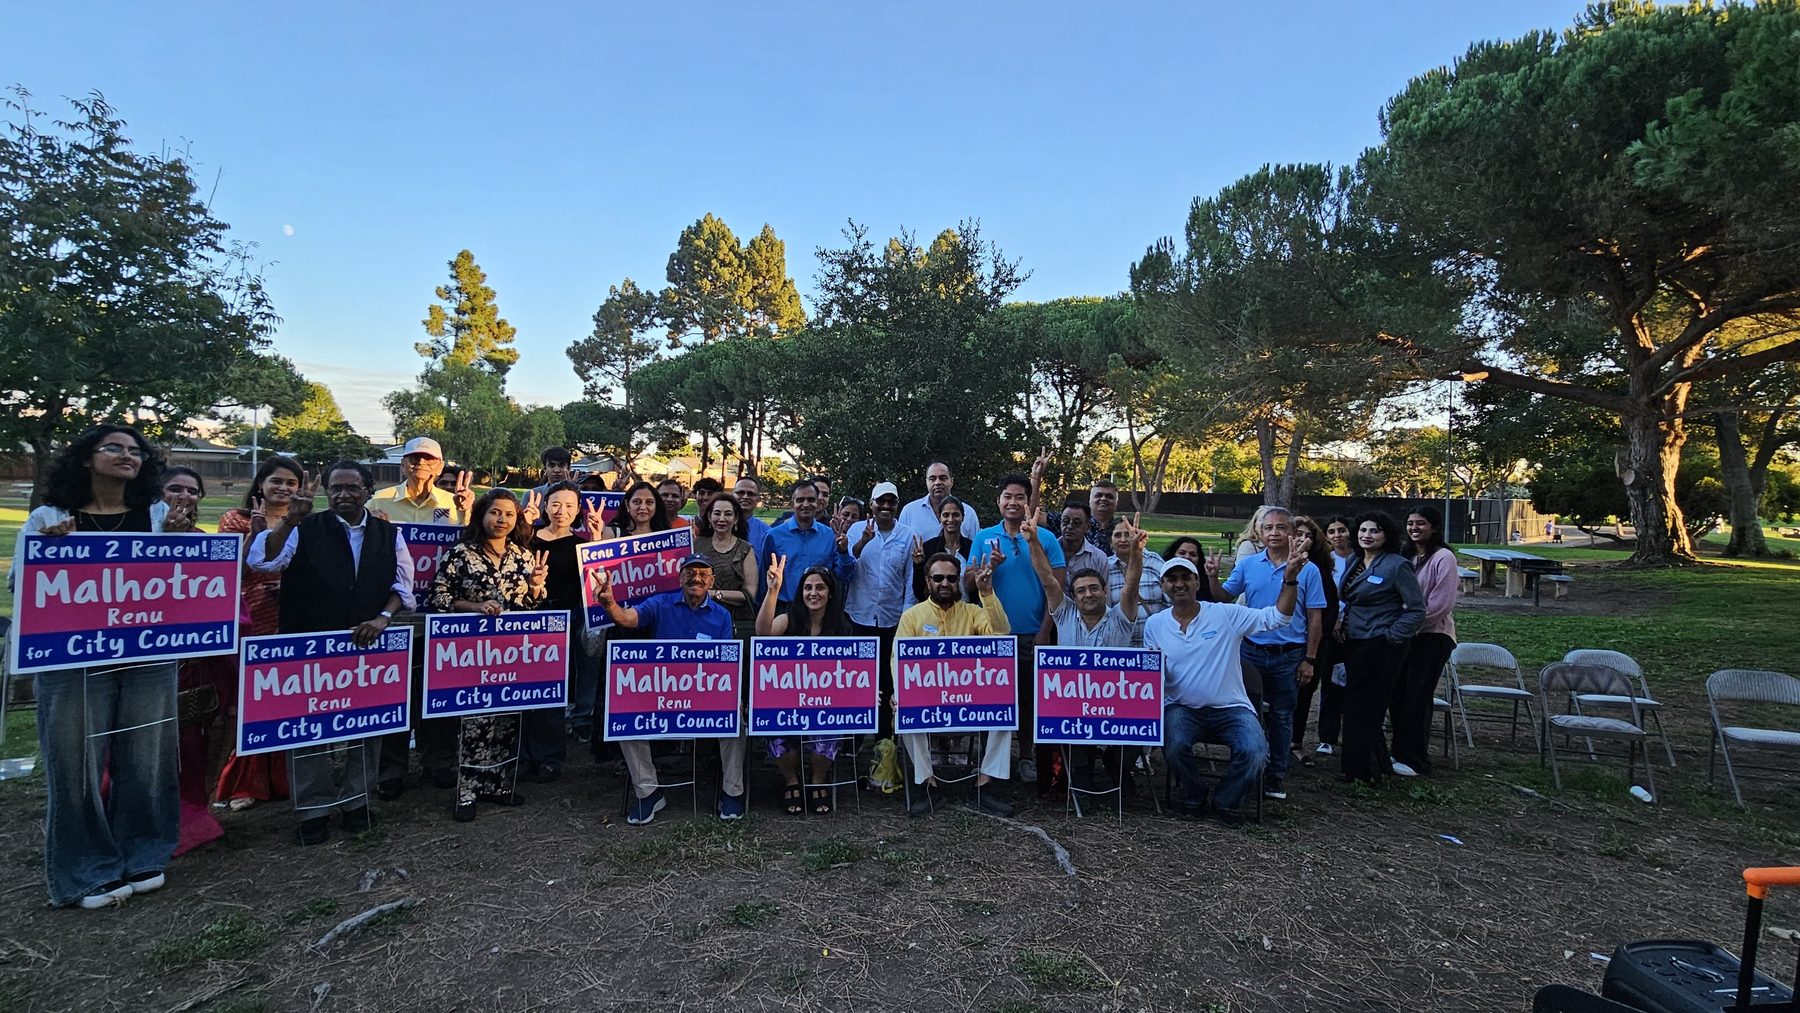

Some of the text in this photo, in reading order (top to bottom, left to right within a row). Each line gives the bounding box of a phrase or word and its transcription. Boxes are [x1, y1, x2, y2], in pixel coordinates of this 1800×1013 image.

[28, 540, 208, 560] Renu 2 Renew!
[582, 534, 675, 563] Renu 2 Renew!
[35, 563, 227, 608] Malhotra
[627, 584, 656, 598] Renu
[108, 607, 163, 626] Renu
[431, 616, 547, 635] Renu 2 Renew!
[592, 614, 605, 623] for
[26, 625, 229, 660] for City Council
[247, 634, 386, 661] Renu 2 Renw!
[436, 634, 559, 671] Malhotra
[612, 645, 719, 661] Renu 2 Renew!
[755, 642, 858, 657] Renu 2 Renew!
[899, 641, 996, 657] Renu 2 Renew!
[1039, 652, 1141, 668] Renu 2 Renew!
[253, 655, 400, 701] Malhotra
[480, 669, 517, 684] Renu
[616, 663, 732, 696] Malhotra
[760, 660, 870, 691] Malhotra
[903, 658, 1009, 690] Malhotra
[431, 682, 561, 708] for City Council
[1043, 670, 1155, 700] Malhotra
[308, 697, 351, 714] Renu
[657, 696, 692, 710] Renu
[799, 693, 832, 707] Renu
[941, 690, 973, 704] Renu
[755, 709, 872, 730] for City Council
[902, 706, 1012, 727] for City Council
[1082, 702, 1115, 716] Renu
[247, 705, 403, 744] for City Council
[611, 712, 733, 733] for City Council
[1041, 718, 1157, 739] for City Council
